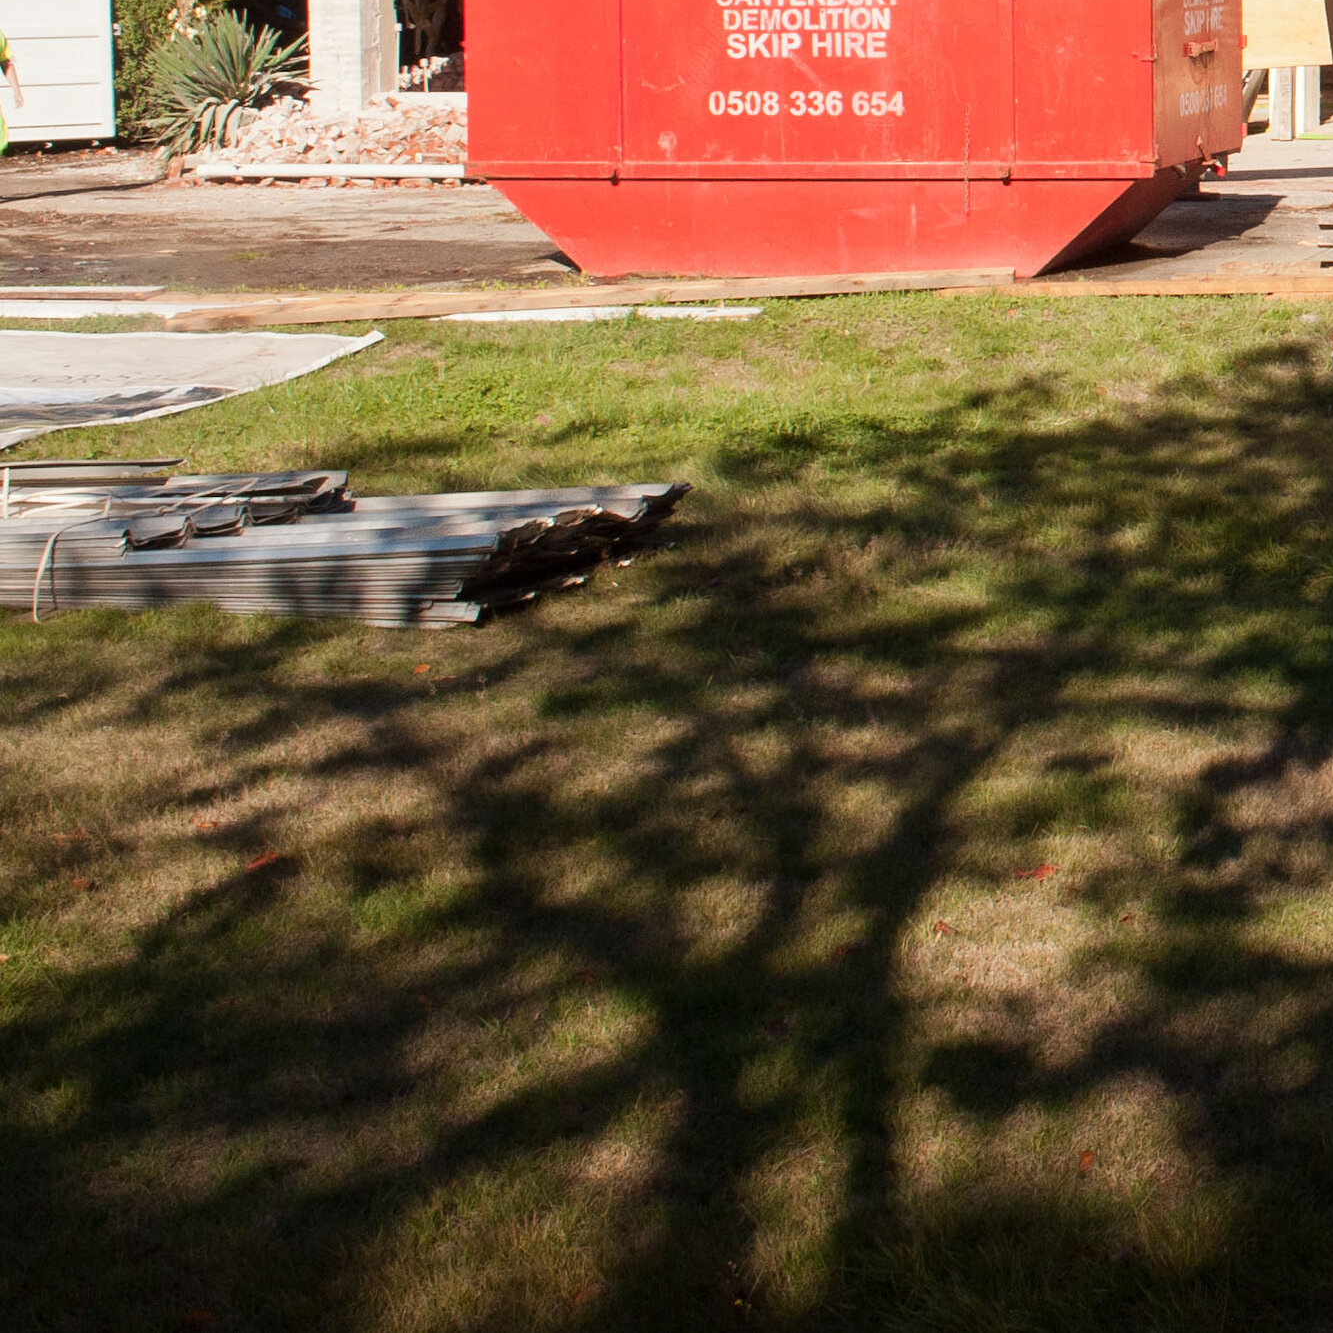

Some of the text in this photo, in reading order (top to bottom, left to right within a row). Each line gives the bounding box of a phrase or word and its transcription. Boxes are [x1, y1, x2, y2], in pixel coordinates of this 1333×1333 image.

[722, 8, 891, 30] DEMOLITION
[726, 32, 888, 59] SKIP HIRE
[708, 90, 905, 116] 0508 336 654
